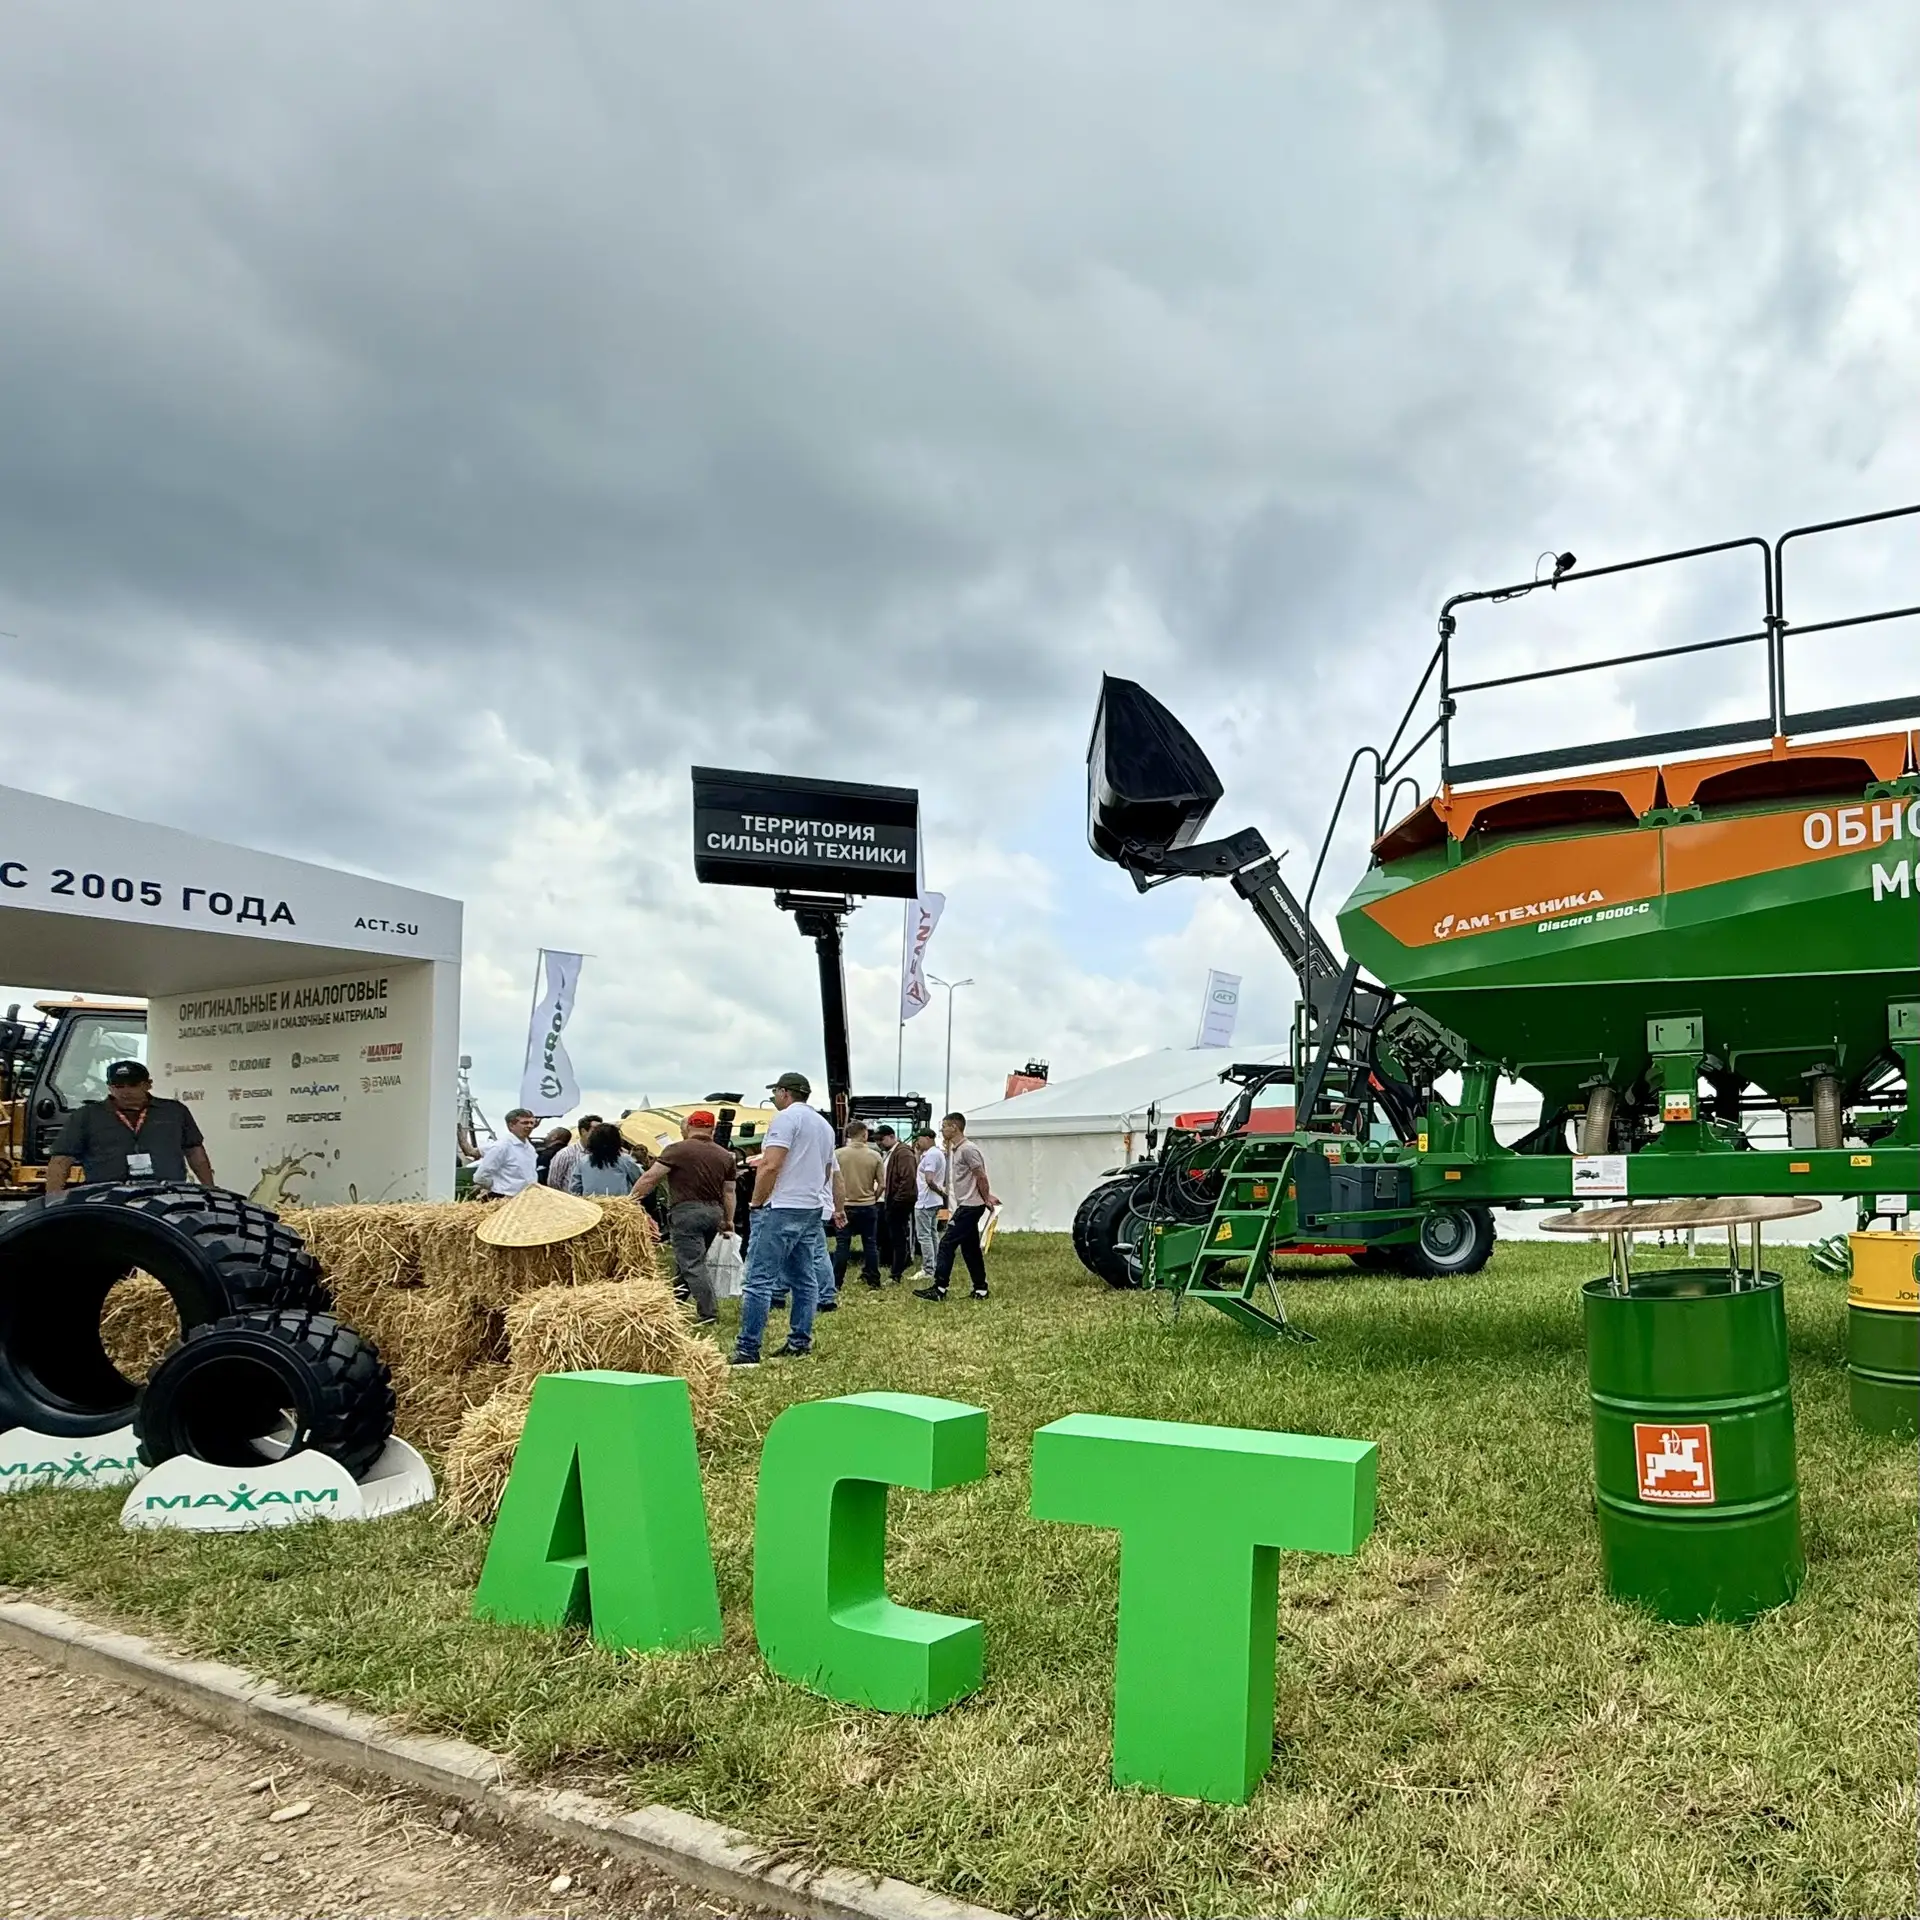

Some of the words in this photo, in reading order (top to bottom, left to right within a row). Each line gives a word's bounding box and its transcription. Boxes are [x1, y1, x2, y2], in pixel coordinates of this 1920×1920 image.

[741, 815, 875, 842] ТЕРРИТОРИЯ
[707, 833, 807, 857] СИЛЬНОЙ
[814, 841, 907, 865] ТЕХНИКИ
[0, 862, 28, 888] С
[51, 869, 162, 906] 2005
[183, 887, 296, 926] ГОДА
[1872, 860, 1919, 902] М
[1269, 885, 1313, 946] ROSFORC
[1455, 889, 1604, 932] АМ-ТЕХНИКА
[1595, 903, 1650, 921] 9000-C
[354, 917, 419, 935] ACT.SU
[179, 991, 277, 1021] ОРИГИНАЛЬНЫЕ
[280, 991, 290, 1010] И
[293, 978, 388, 1009] АНАЛОГОВЫЕ
[273, 1018, 279, 1030] И
[280, 1012, 331, 1030] СМАЗОЧНЫЕ
[333, 1006, 387, 1023] МАТЕРИАЛЫ
[242, 1088, 273, 1099] ENSIGN
[290, 1081, 340, 1096] MAXAM
[286, 1111, 342, 1123] ROSFORCE
[0, 1451, 139, 1481] MAXA
[146, 1482, 338, 1512] MAXAM
[1641, 1489, 1711, 1498] AMAZONE
